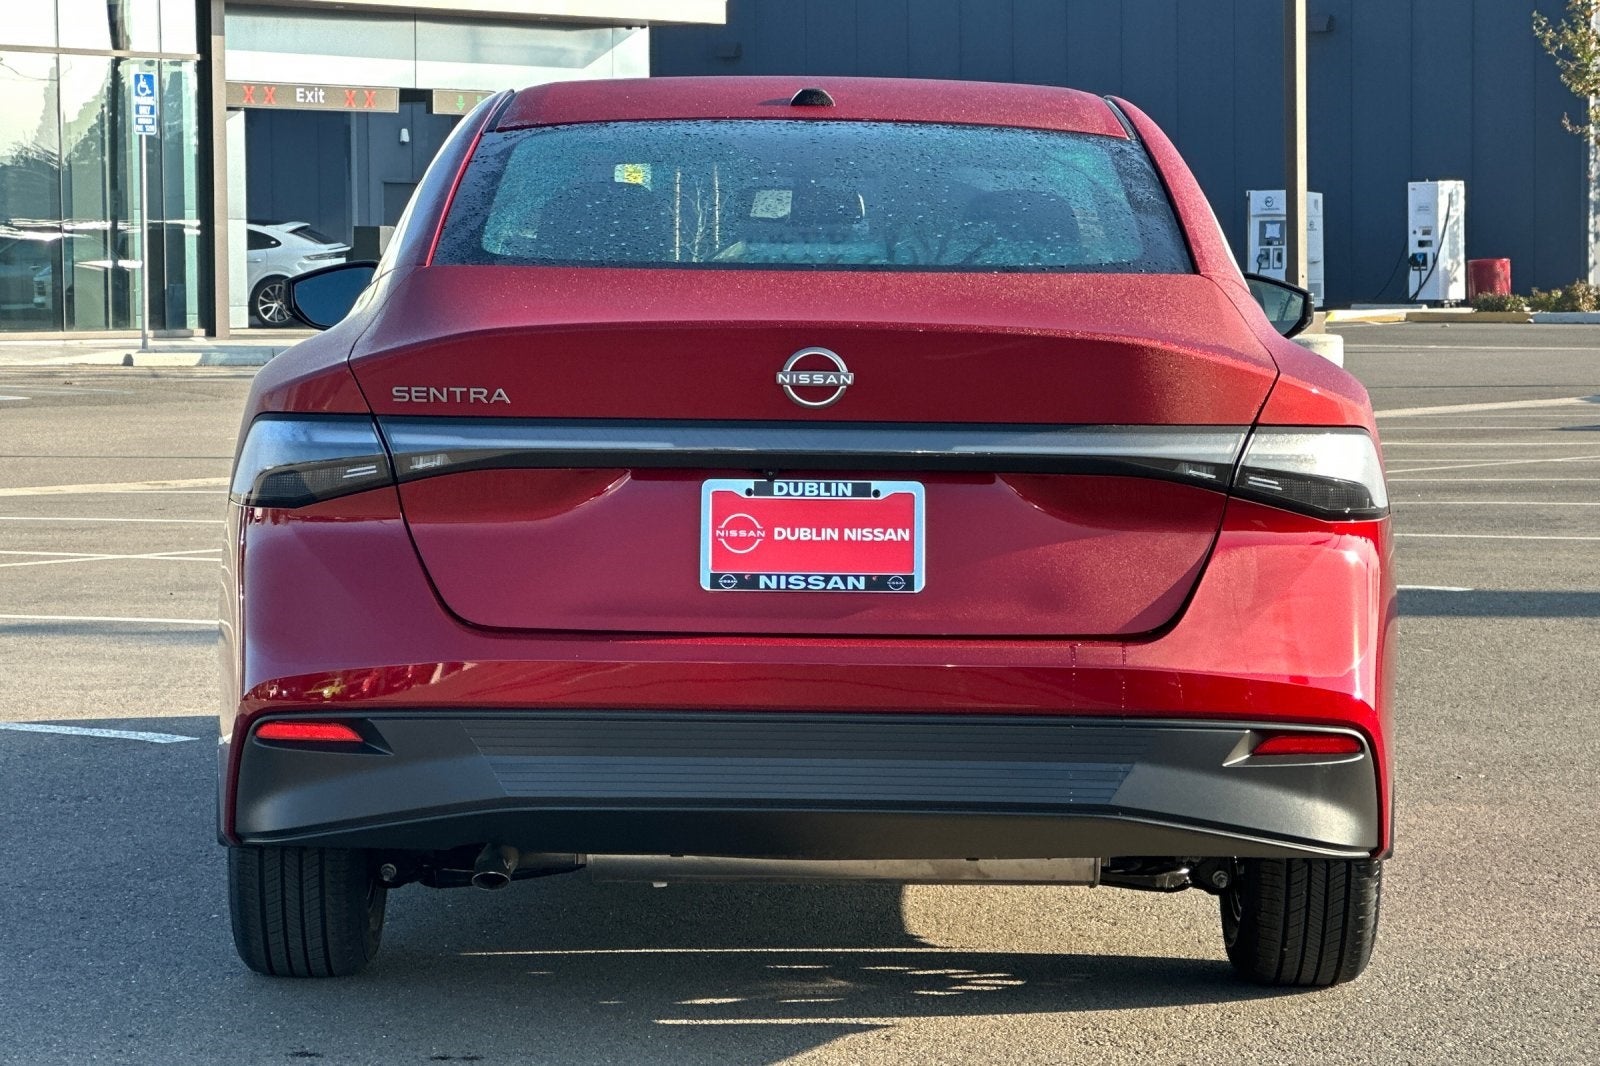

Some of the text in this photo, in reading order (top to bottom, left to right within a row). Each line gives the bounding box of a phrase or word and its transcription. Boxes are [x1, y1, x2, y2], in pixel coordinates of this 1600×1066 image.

[295, 87, 325, 104] Exit
[778, 373, 852, 385] NISSAN
[391, 386, 511, 404] SENTRA
[773, 482, 852, 496] DUBLIN
[716, 530, 765, 538] NISSAN
[773, 527, 910, 541] DUBLIN NISSAN
[759, 575, 866, 590] NISSAN
